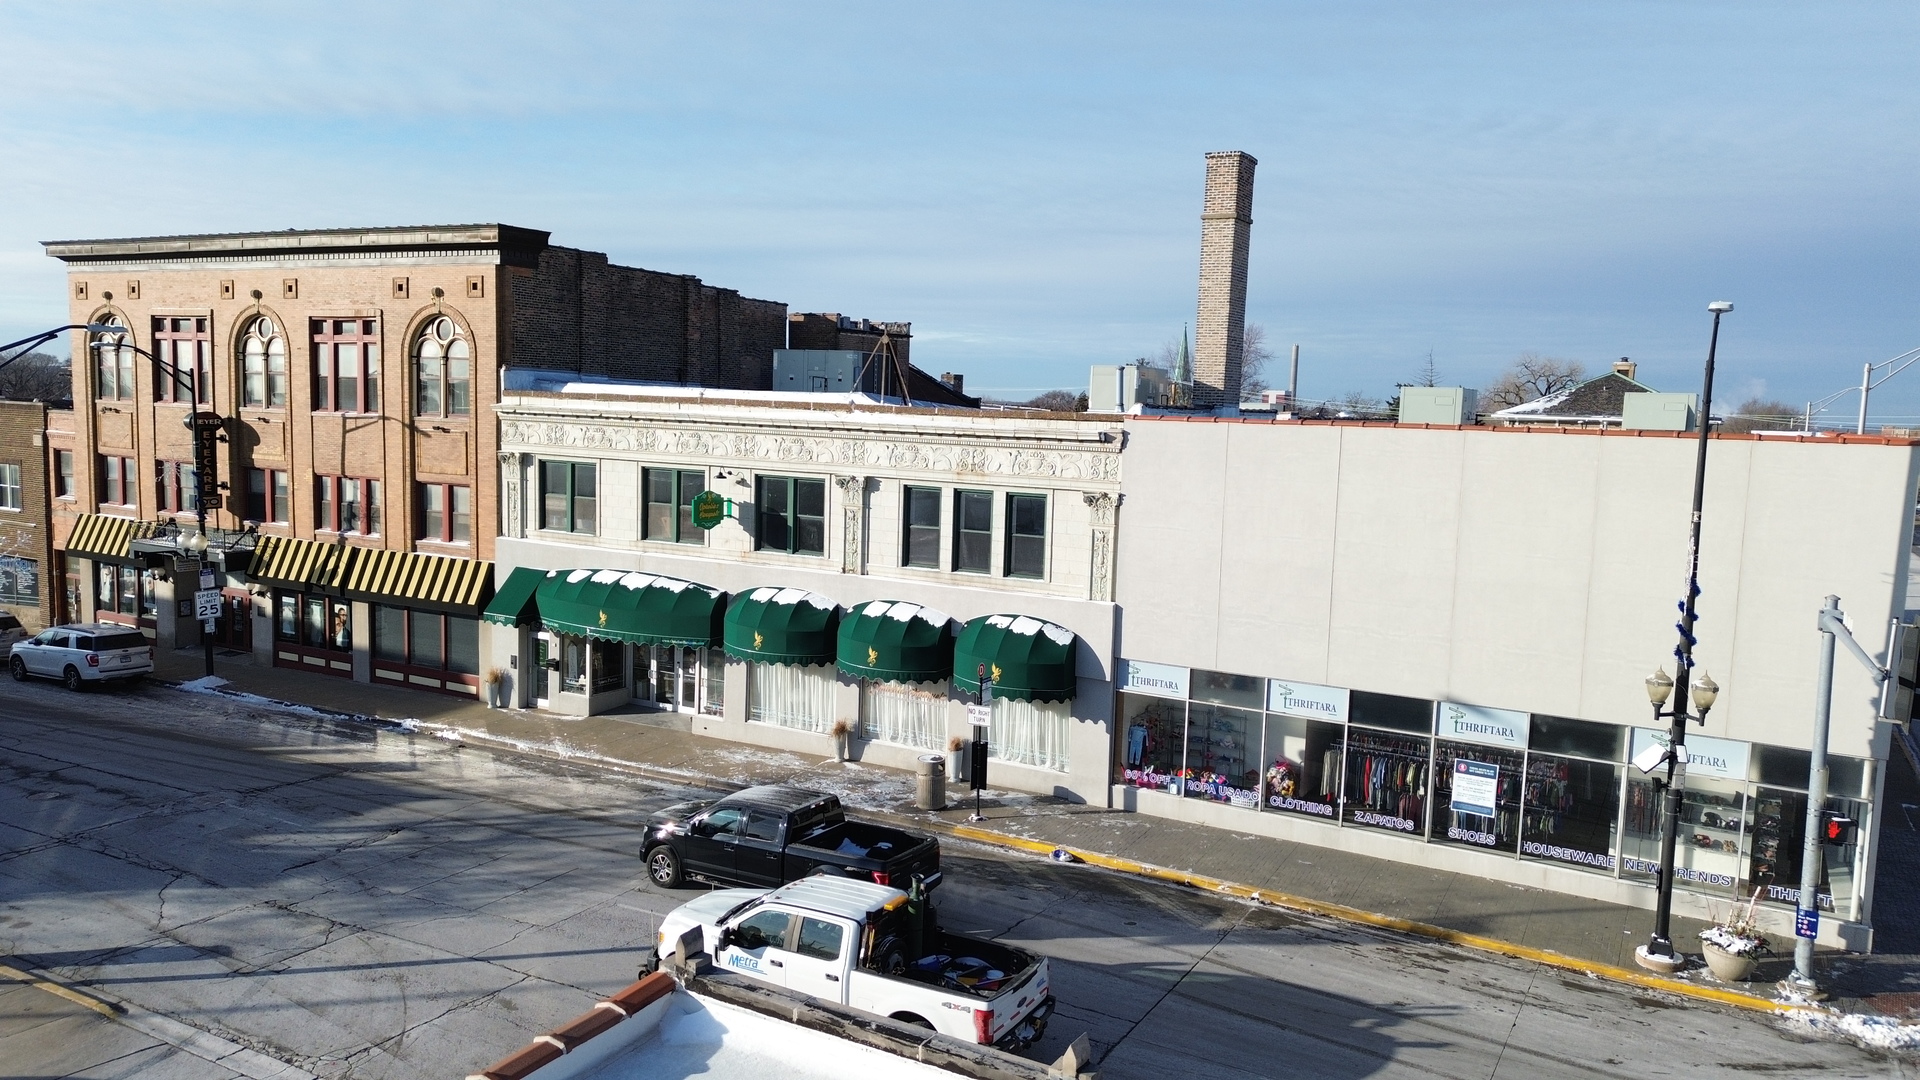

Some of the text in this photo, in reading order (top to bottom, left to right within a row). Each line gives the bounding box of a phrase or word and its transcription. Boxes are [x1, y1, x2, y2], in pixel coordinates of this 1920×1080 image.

[203, 431, 212, 492] EYECARE
[197, 592, 219, 600] SPEED
[199, 604, 219, 616] 25
[1135, 676, 1180, 691] THRIFTARA
[1288, 697, 1337, 713] THRIFTARA
[1458, 721, 1515, 738] THRIFTARA
[1688, 754, 1728, 769] IFTARA
[1218, 785, 1260, 801] USADO
[1269, 795, 1333, 816] CLOTHING
[1354, 810, 1415, 831] ZAPATOS
[1447, 826, 1496, 846] SHOES
[1521, 840, 1617, 869] HOUSEWARE
[1624, 858, 1733, 887] NEW RENDS
[1767, 884, 1833, 908] THRT
[728, 954, 759, 969] Metra
